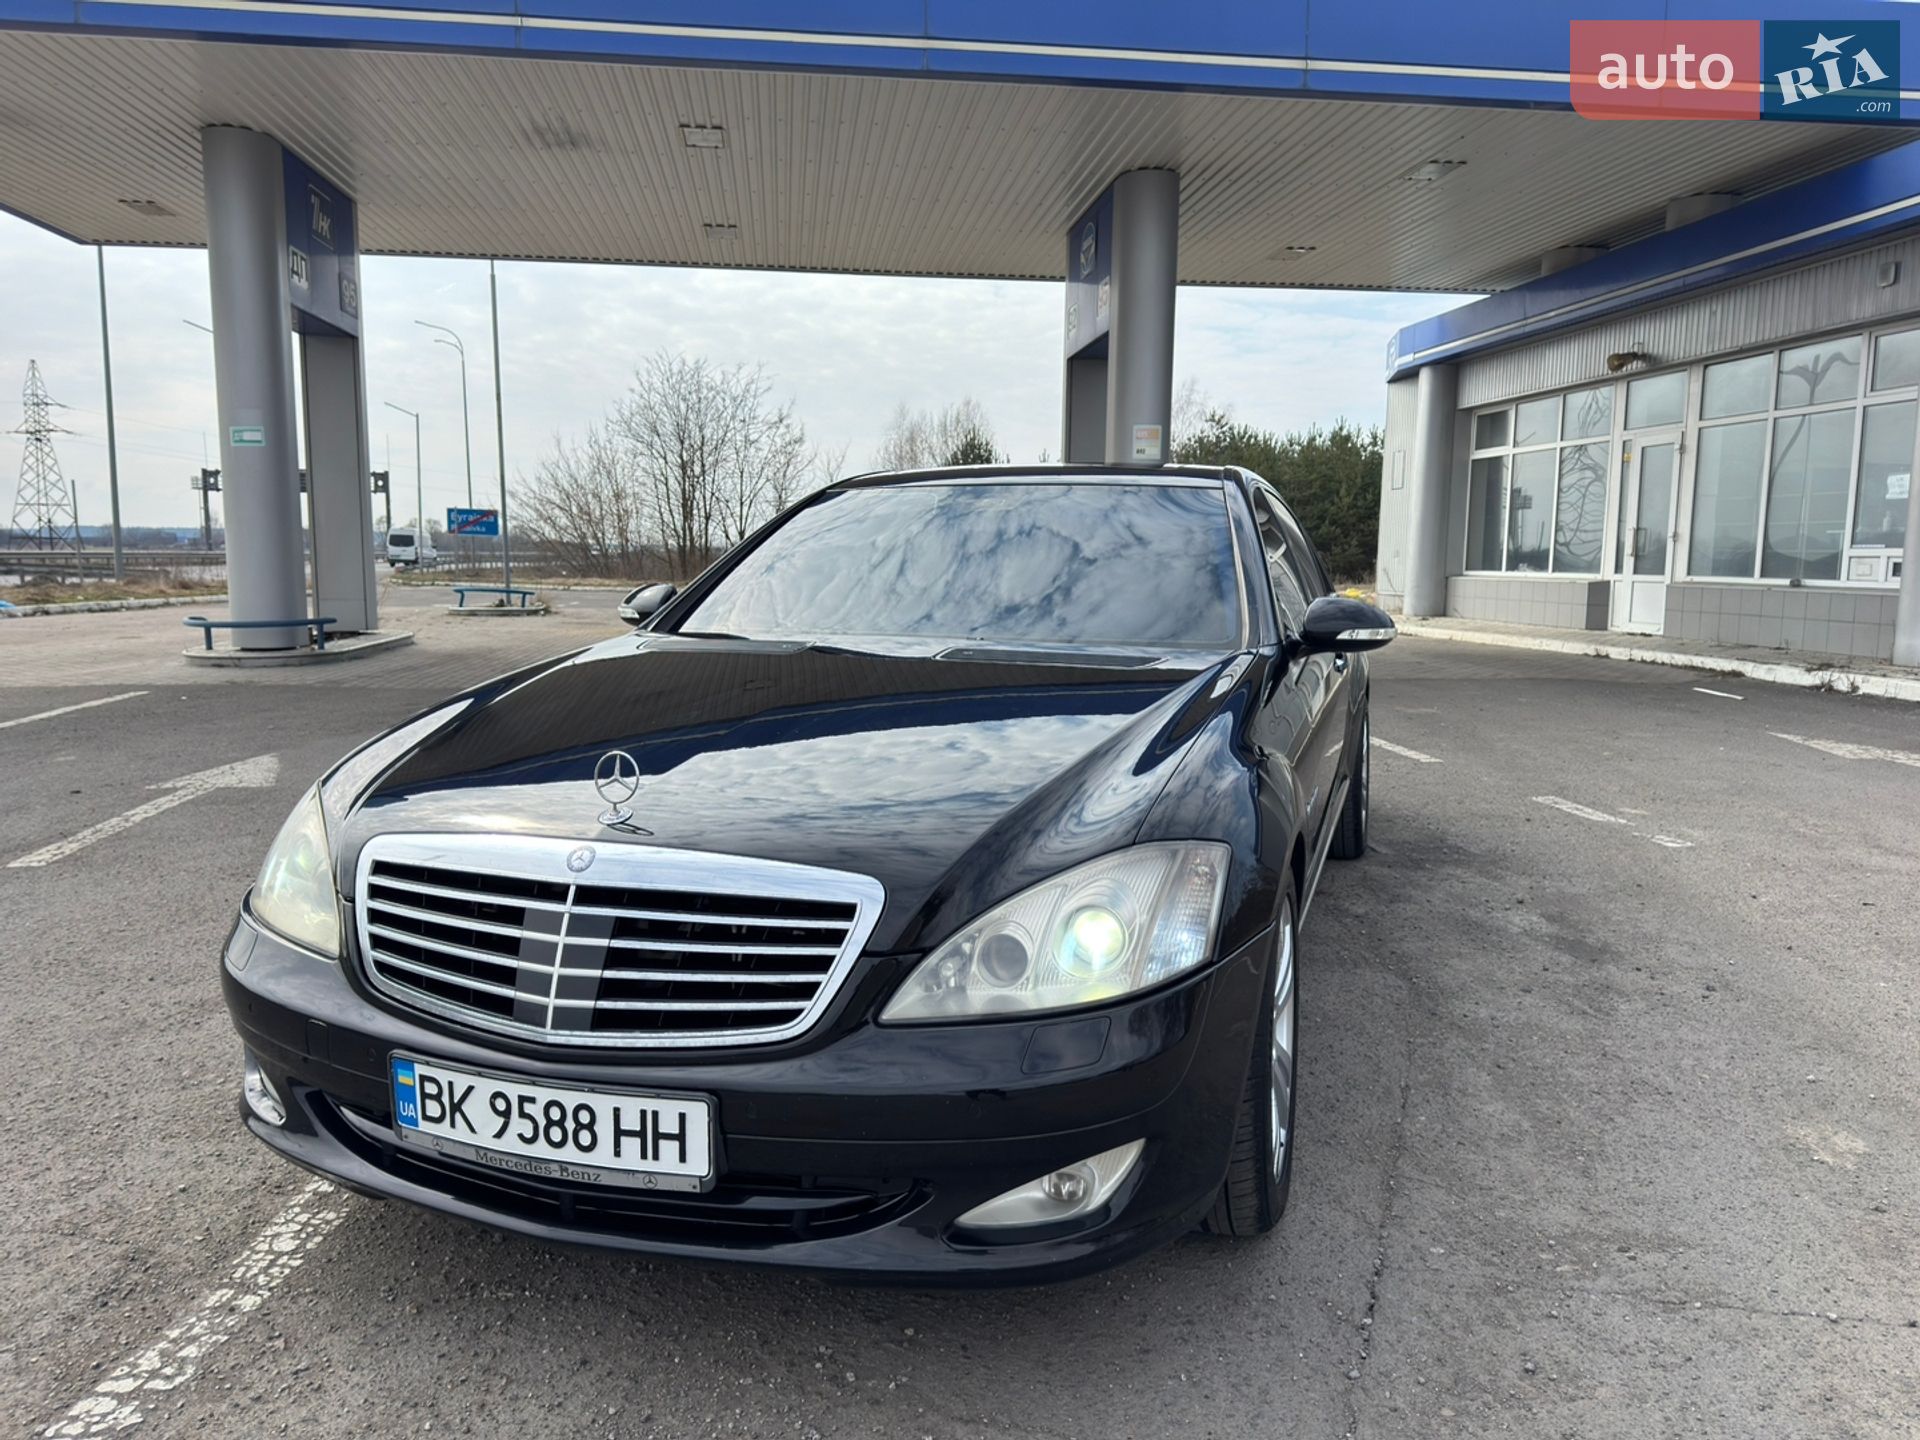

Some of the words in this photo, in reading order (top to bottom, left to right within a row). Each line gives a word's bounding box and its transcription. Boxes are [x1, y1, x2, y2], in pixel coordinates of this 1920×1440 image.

[399, 1100, 417, 1119] UA
[418, 1073, 478, 1135] BK
[489, 1090, 598, 1153] 9588
[612, 1106, 687, 1164] HH
[474, 1149, 602, 1183] Mercedes-Benz
